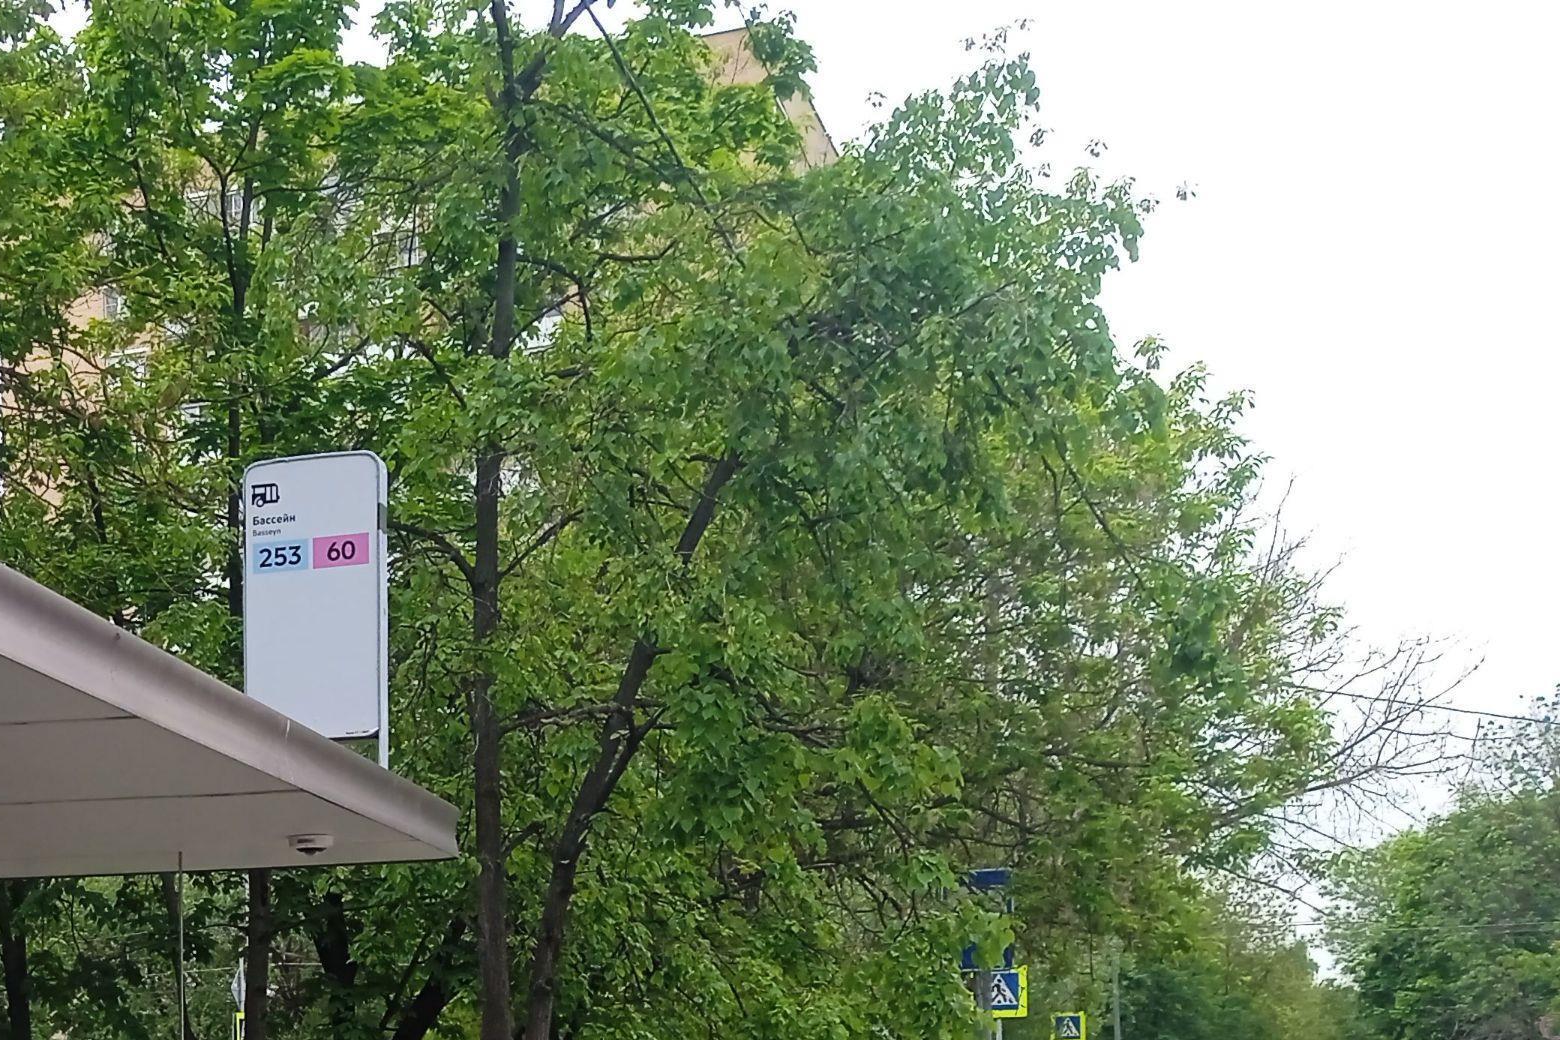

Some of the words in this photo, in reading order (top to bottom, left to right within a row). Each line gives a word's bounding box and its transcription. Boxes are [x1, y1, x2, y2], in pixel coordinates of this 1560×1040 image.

[252, 513, 296, 526] Бассейн
[252, 528, 282, 537] Basseyn
[259, 545, 302, 568] 253
[327, 540, 356, 562] 60
